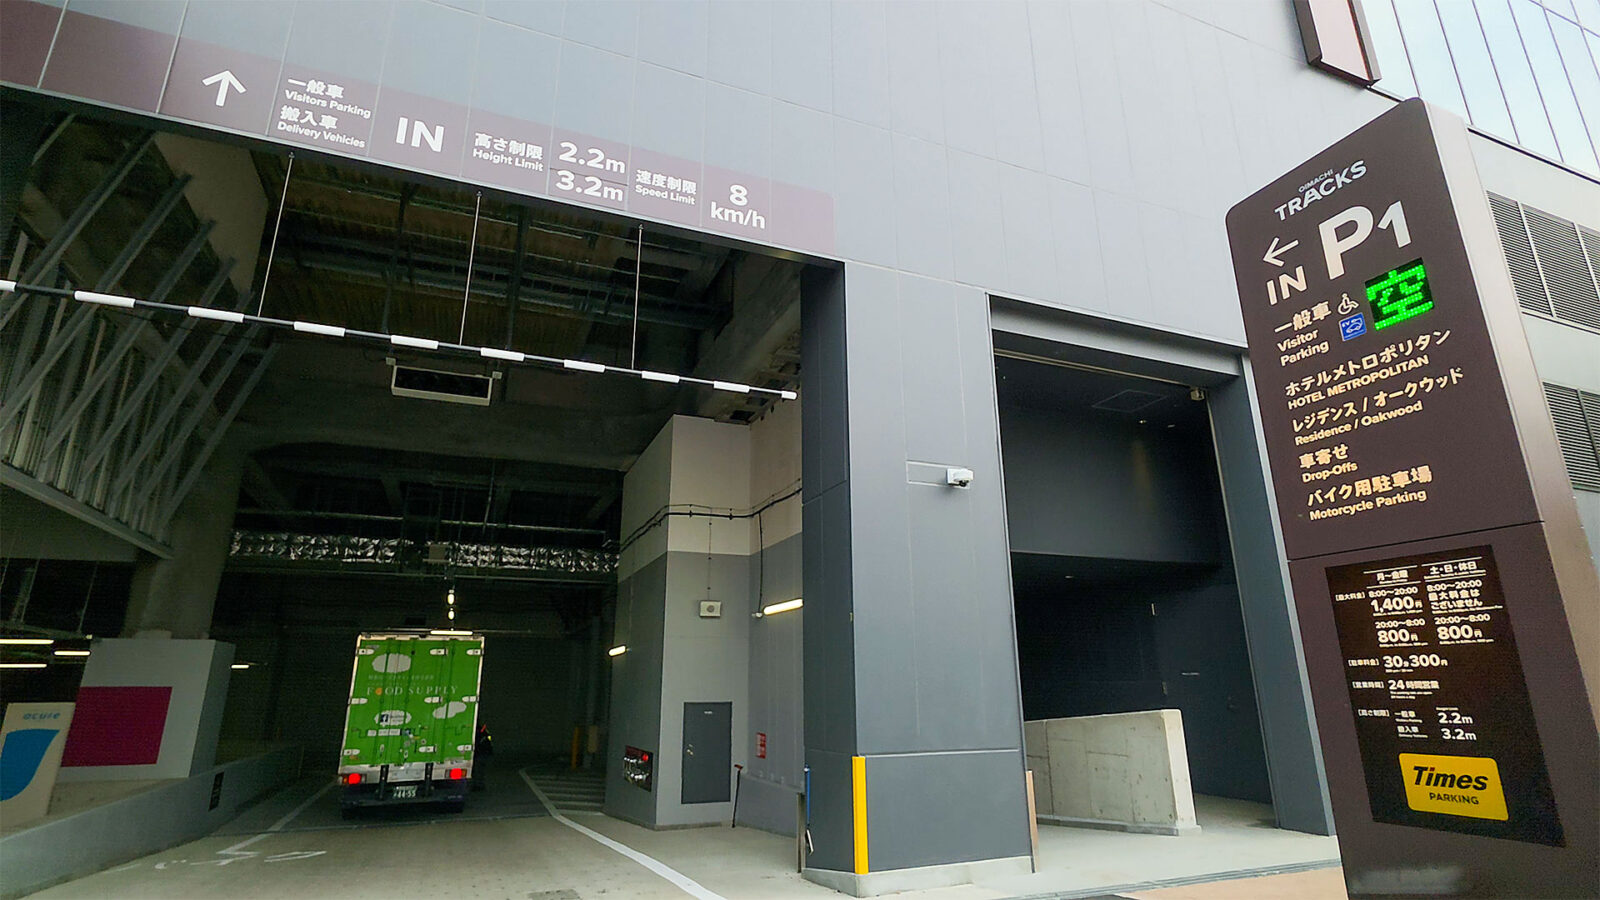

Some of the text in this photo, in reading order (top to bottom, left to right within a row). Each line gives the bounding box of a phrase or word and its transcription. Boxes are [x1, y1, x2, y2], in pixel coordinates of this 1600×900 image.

[287, 79, 344, 99] 一般車
[280, 105, 338, 130] 搬入車
[285, 90, 372, 119] Visitors Parking
[277, 121, 366, 148] Delivery Vehicles
[395, 117, 445, 152] IN
[474, 132, 544, 161] 高さ制限
[472, 148, 544, 172] Height Limit
[558, 141, 626, 174] 2.2m
[555, 170, 624, 202] 3.2m
[635, 169, 697, 196] 速度制限
[1274, 160, 1368, 222] TRACKS
[1298, 168, 1333, 193] OIMACHI
[635, 184, 696, 206] Speed Limit
[728, 184, 749, 206] 8
[710, 201, 766, 229] km/h
[1318, 200, 1412, 281] P1
[1266, 265, 1308, 307] IN
[1366, 263, 1434, 332] 空
[1274, 301, 1332, 332] 一般車
[1277, 329, 1319, 353] Visitor
[1280, 341, 1330, 367] Parking
[1285, 329, 1451, 398] ホテルメトロポリタン
[1288, 354, 1430, 410] HOTEL METROPOLITAN
[1292, 401, 1358, 434] レジデンス
[1373, 366, 1465, 408] オークウッド
[1294, 422, 1352, 446] Residence
[1361, 400, 1424, 427] Oakwood
[1299, 443, 1349, 470] 車寄せ
[1302, 461, 1359, 484] Drop-Offs
[1307, 464, 1434, 507] バイク用駐車場
[1309, 489, 1428, 521] Motorcycle Parking
[408, 684, 459, 696] SUPPLY
[1437, 712, 1474, 725] 2.2m
[1440, 728, 1478, 741] 3.2m
[1412, 765, 1489, 791] Times
[1429, 792, 1480, 805] PARKING
